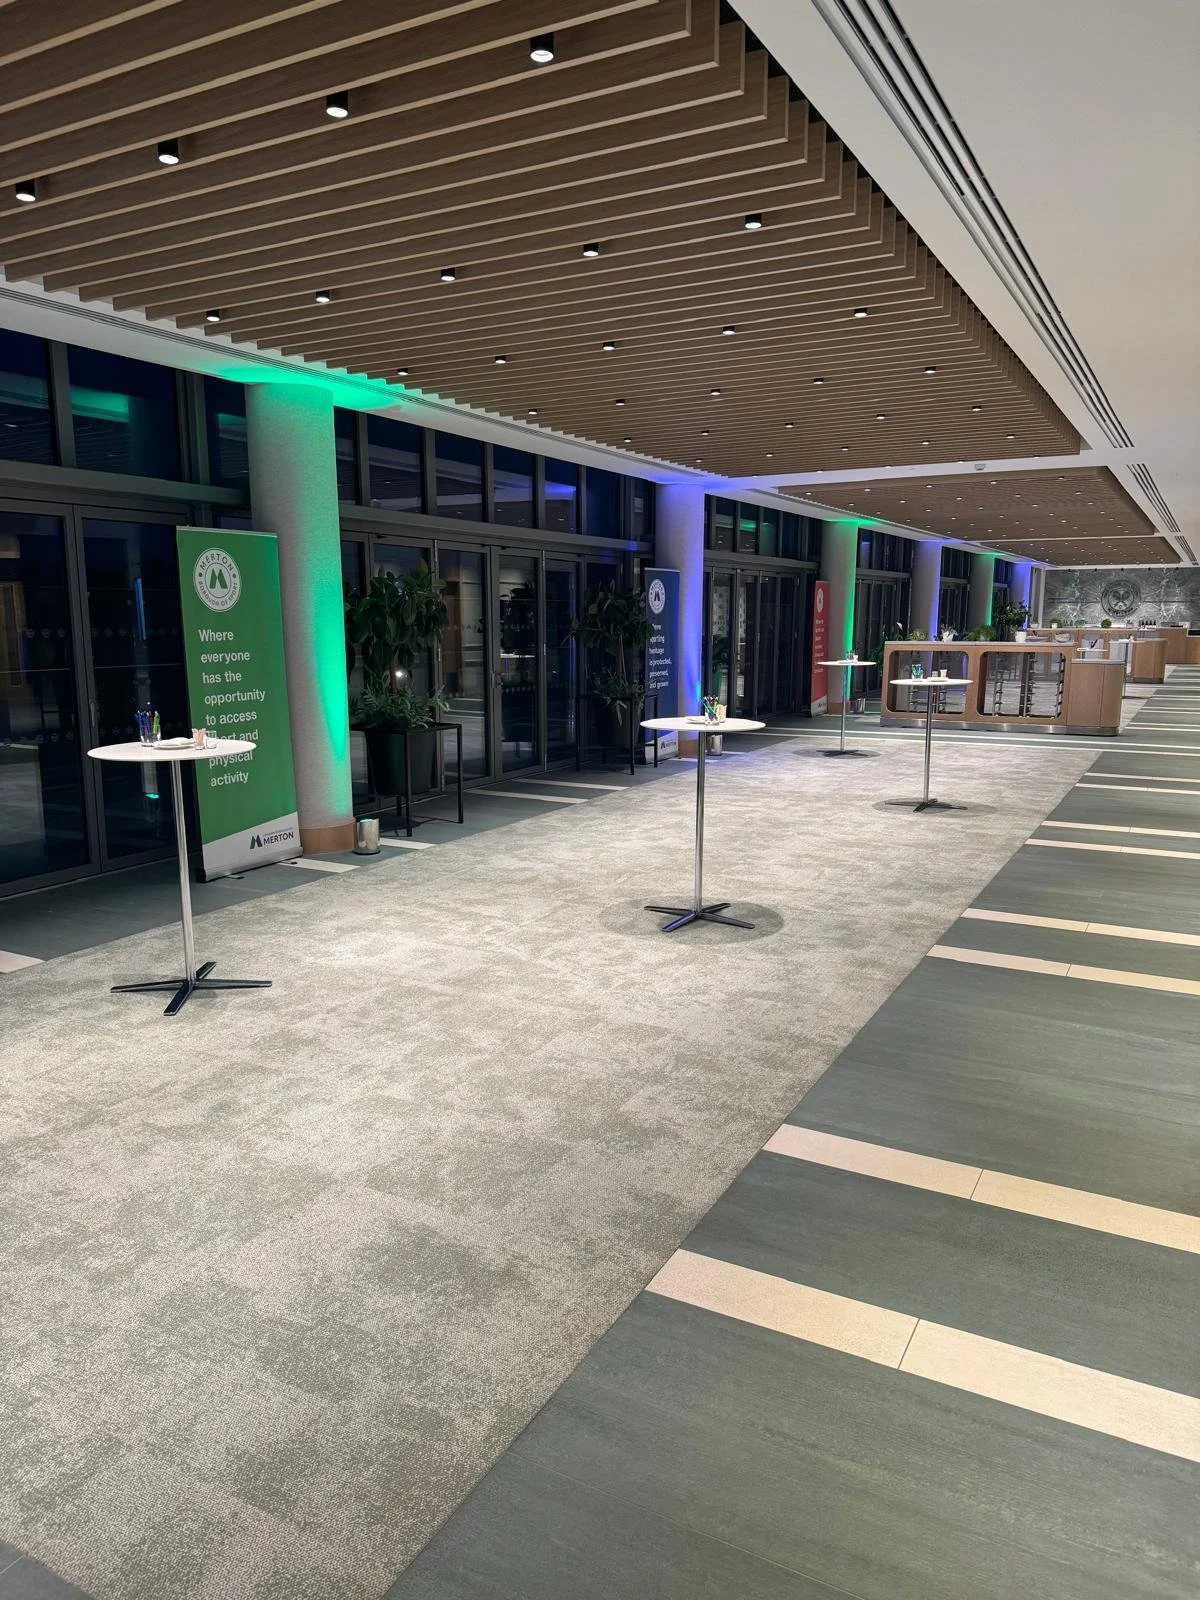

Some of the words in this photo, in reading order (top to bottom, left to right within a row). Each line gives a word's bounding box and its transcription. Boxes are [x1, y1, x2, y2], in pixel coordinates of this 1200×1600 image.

[200, 554, 234, 571] MERTON
[198, 629, 234, 642] Where
[200, 651, 251, 664] everyone
[202, 672, 222, 684] has
[224, 670, 242, 683] the
[204, 689, 266, 706] opportunity
[205, 714, 217, 726] to
[219, 710, 257, 725] access
[239, 728, 259, 741] and
[209, 749, 253, 769] physical
[210, 771, 249, 787] activity
[263, 831, 294, 846] MERTON
